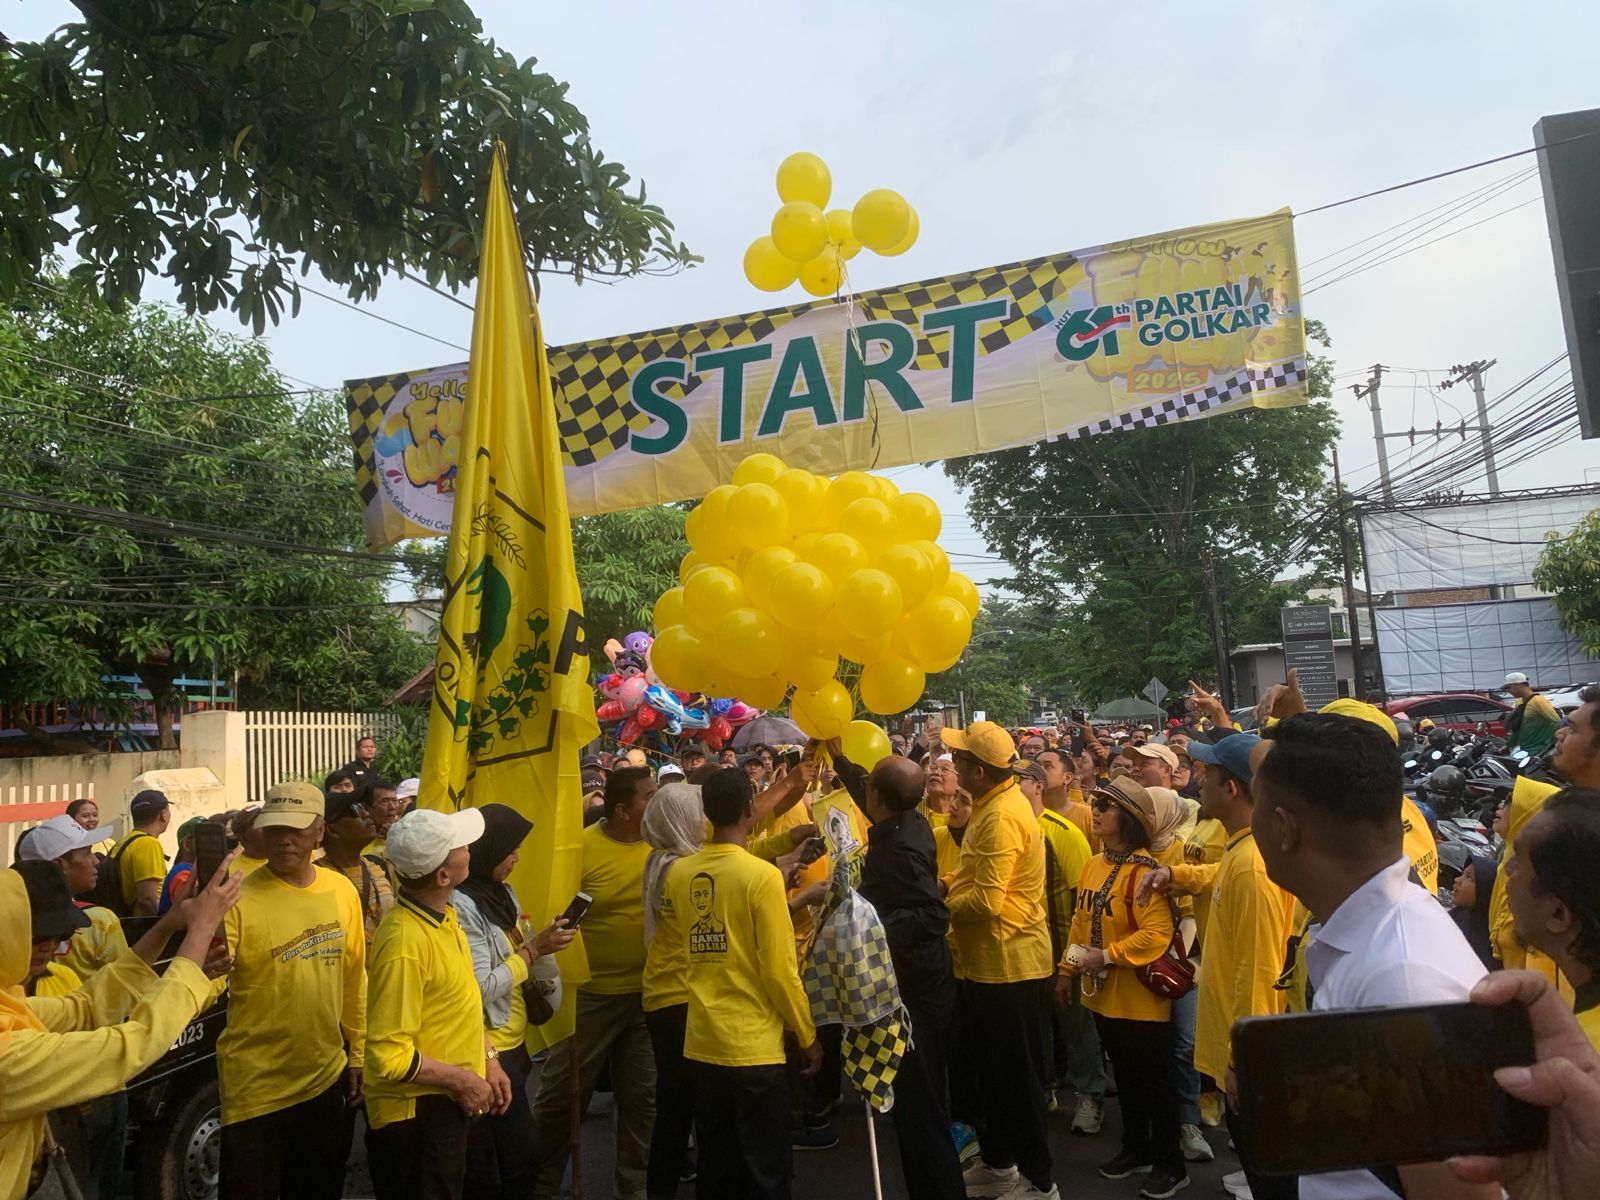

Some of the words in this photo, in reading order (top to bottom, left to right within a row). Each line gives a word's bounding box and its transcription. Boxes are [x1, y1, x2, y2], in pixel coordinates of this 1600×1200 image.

[1136, 284, 1243, 322] PARTAI
[1055, 309, 1072, 330] HUT
[1138, 303, 1271, 347] GOLKAR
[629, 299, 1008, 455] START
[1133, 371, 1202, 391] 2025
[410, 379, 467, 400] Yello
[412, 512, 434, 530] Hati
[434, 520, 451, 531] Cer
